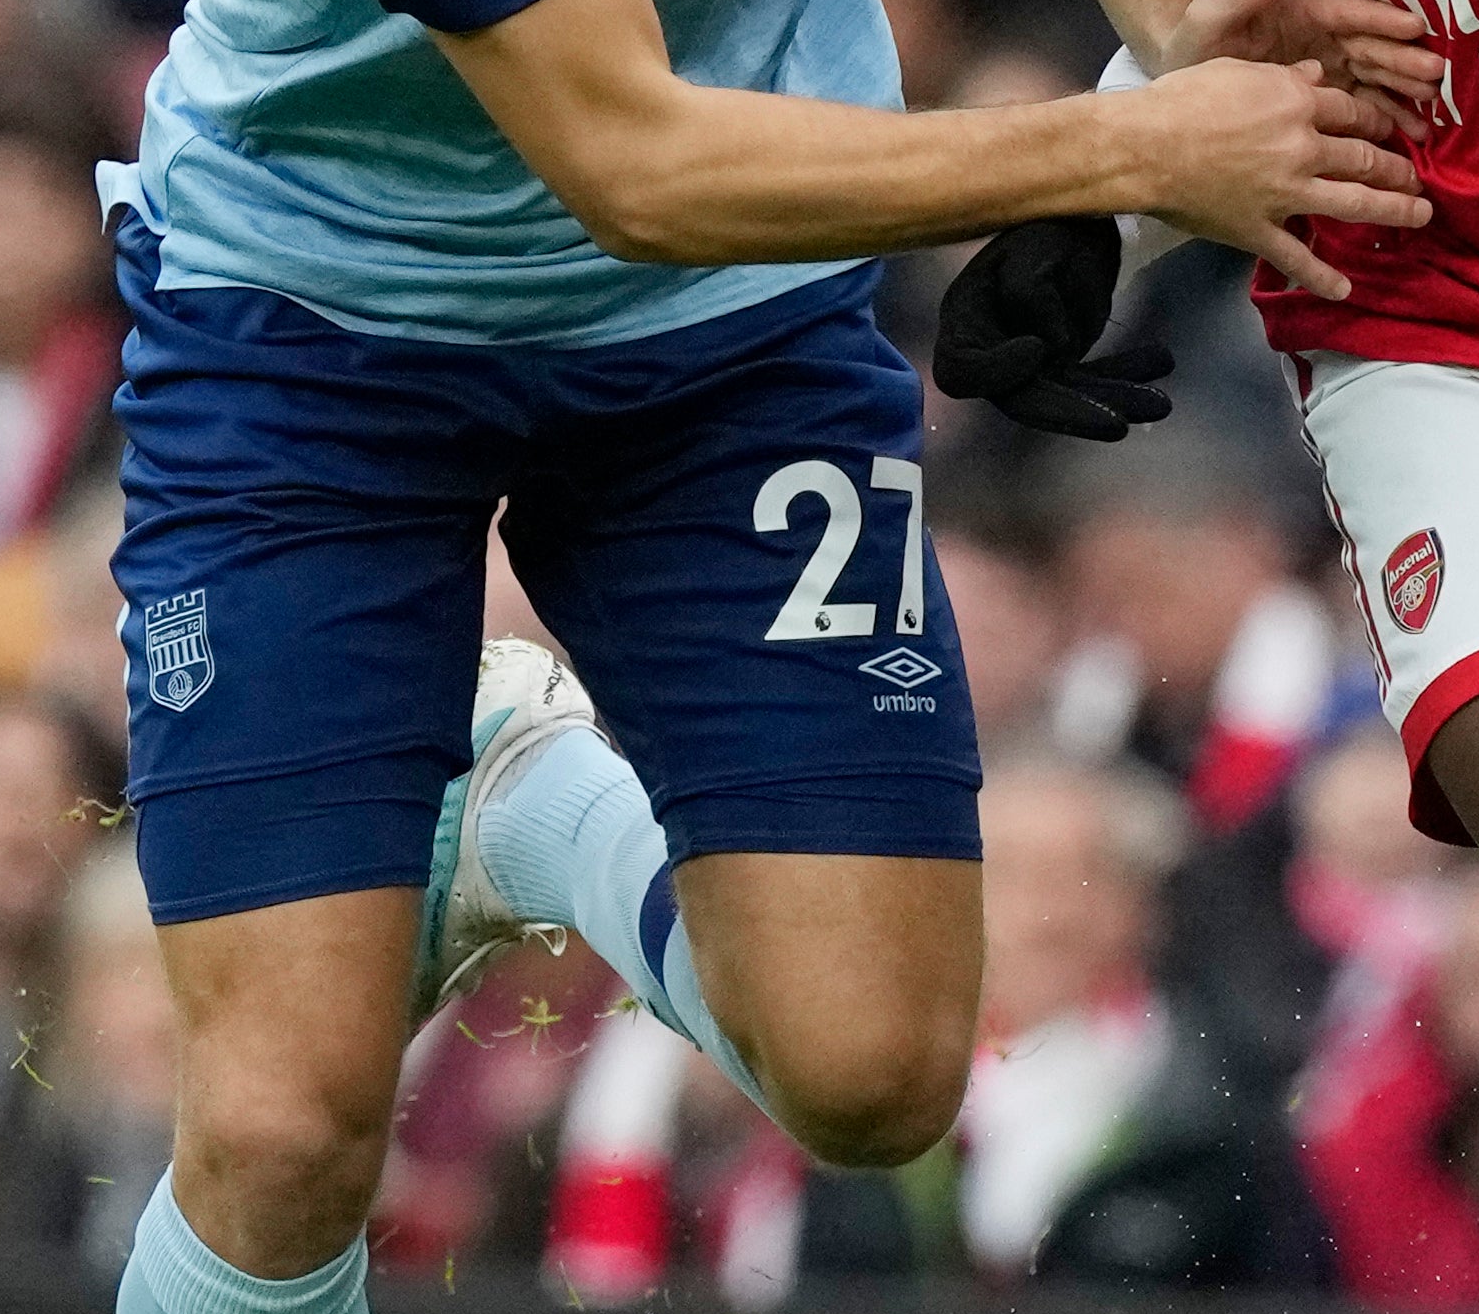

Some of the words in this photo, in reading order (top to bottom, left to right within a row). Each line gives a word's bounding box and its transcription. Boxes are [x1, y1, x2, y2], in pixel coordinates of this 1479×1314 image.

[752, 456, 924, 641] 27
[1389, 541, 1432, 587] Arsenal
[873, 691, 936, 714] umbro
